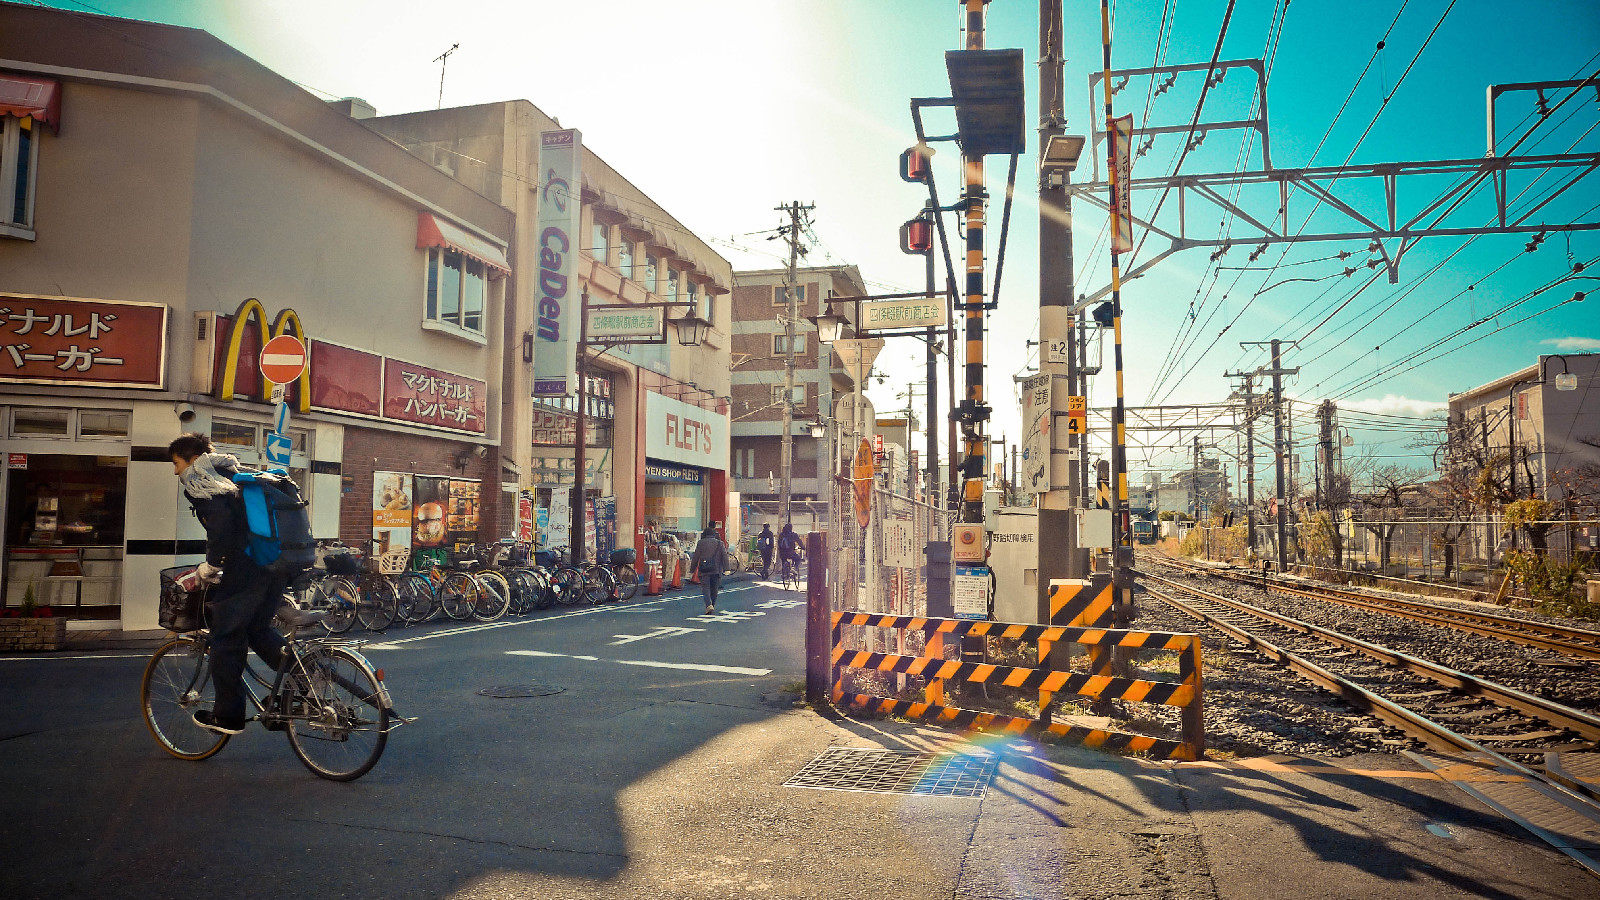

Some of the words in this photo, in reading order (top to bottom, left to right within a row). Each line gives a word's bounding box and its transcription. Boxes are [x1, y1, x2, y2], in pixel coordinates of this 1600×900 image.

[538, 226, 570, 343] CaDen
[401, 370, 475, 402] マクドナルド
[404, 398, 477, 423] ハンバーガー
[666, 412, 712, 455] FLET'S
[1068, 418, 1078, 432] 4
[646, 466, 661, 476] YEN
[661, 468, 682, 478] SHOP
